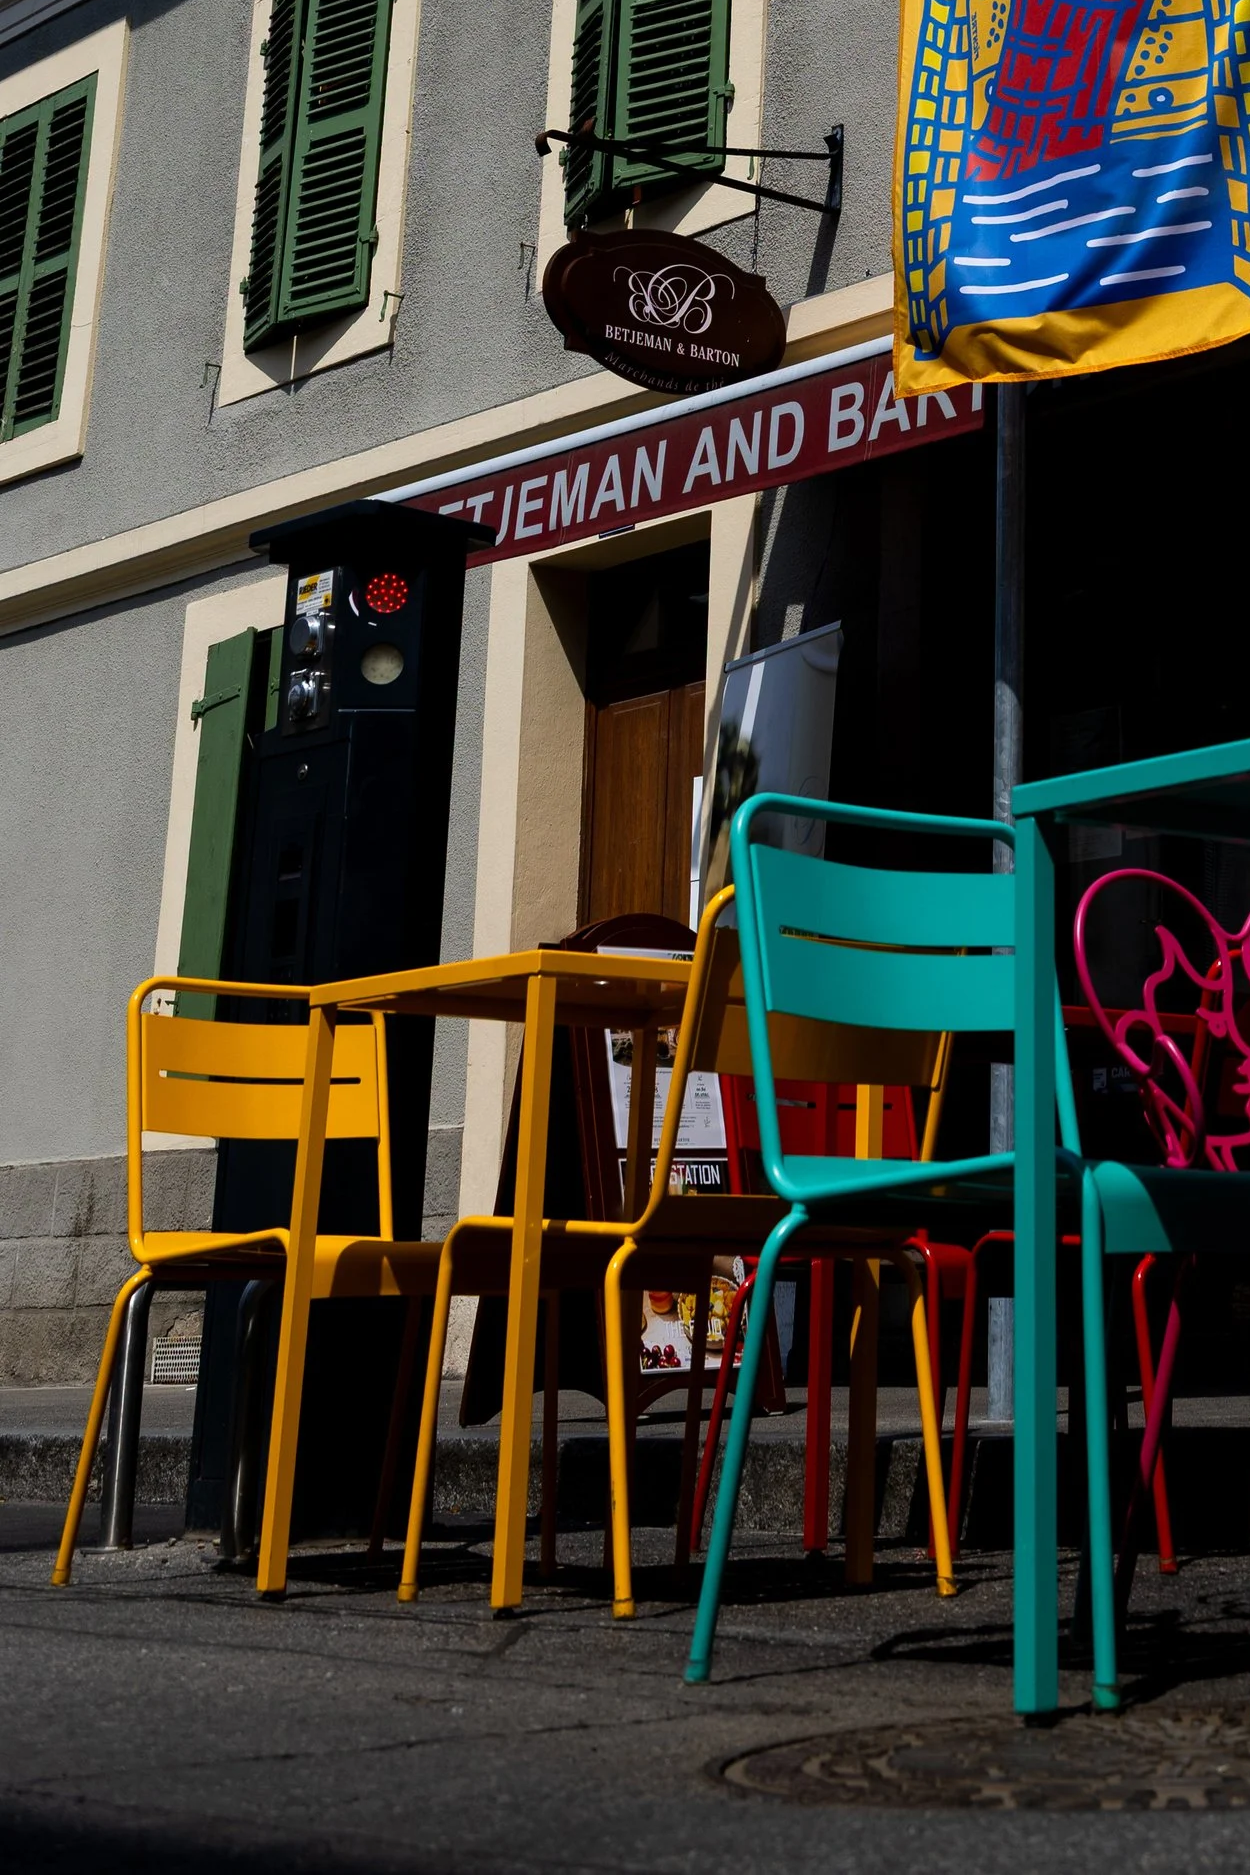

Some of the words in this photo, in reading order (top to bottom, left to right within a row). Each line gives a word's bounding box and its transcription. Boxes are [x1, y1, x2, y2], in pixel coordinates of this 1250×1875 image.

[605, 325, 672, 352] BETJEMAN
[676, 343, 685, 355] &
[690, 344, 740, 367] BARTON
[604, 352, 679, 391] Marchands
[685, 380, 700, 392] de
[682, 400, 805, 494] AND
